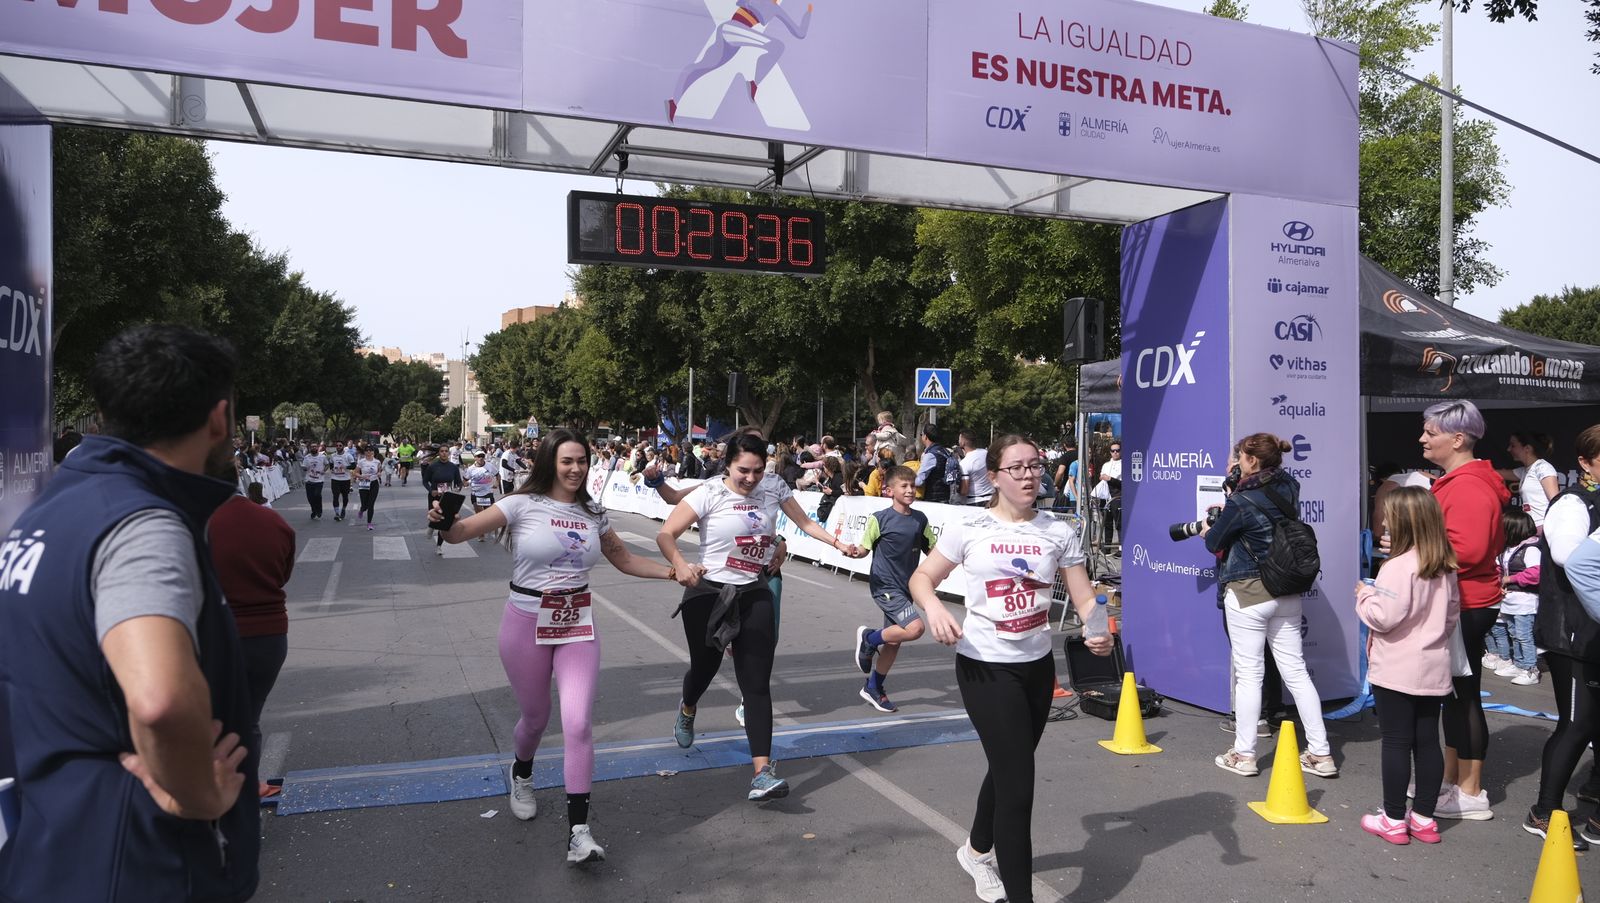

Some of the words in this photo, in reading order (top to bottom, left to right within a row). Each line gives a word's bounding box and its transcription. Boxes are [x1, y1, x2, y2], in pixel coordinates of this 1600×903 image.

[1018, 12, 1051, 43] LA
[1061, 19, 1192, 66] IGUALDAD
[971, 51, 1009, 82] ES
[1016, 57, 1147, 104] NUESTRA
[1152, 81, 1232, 116] META.
[985, 105, 1032, 132] CDX
[1080, 116, 1129, 134] ALMERÍA
[1080, 129, 1106, 140] CIUDAD
[616, 202, 813, 266] 00:29:36
[1270, 242, 1326, 257] HYUNDAI
[1285, 281, 1329, 296] cajamar
[1274, 320, 1313, 342] CASI
[1135, 331, 1206, 389] CDX
[1287, 357, 1327, 371] vithas
[1279, 402, 1326, 419] aqualia
[1152, 449, 1214, 468] ALMERÍA
[1152, 470, 1182, 481] CIUDAD
[550, 519, 588, 530] MUJER
[741, 546, 765, 559] 608
[990, 543, 1042, 556] MUJER
[1004, 590, 1036, 612] 807
[551, 609, 580, 622] 625
